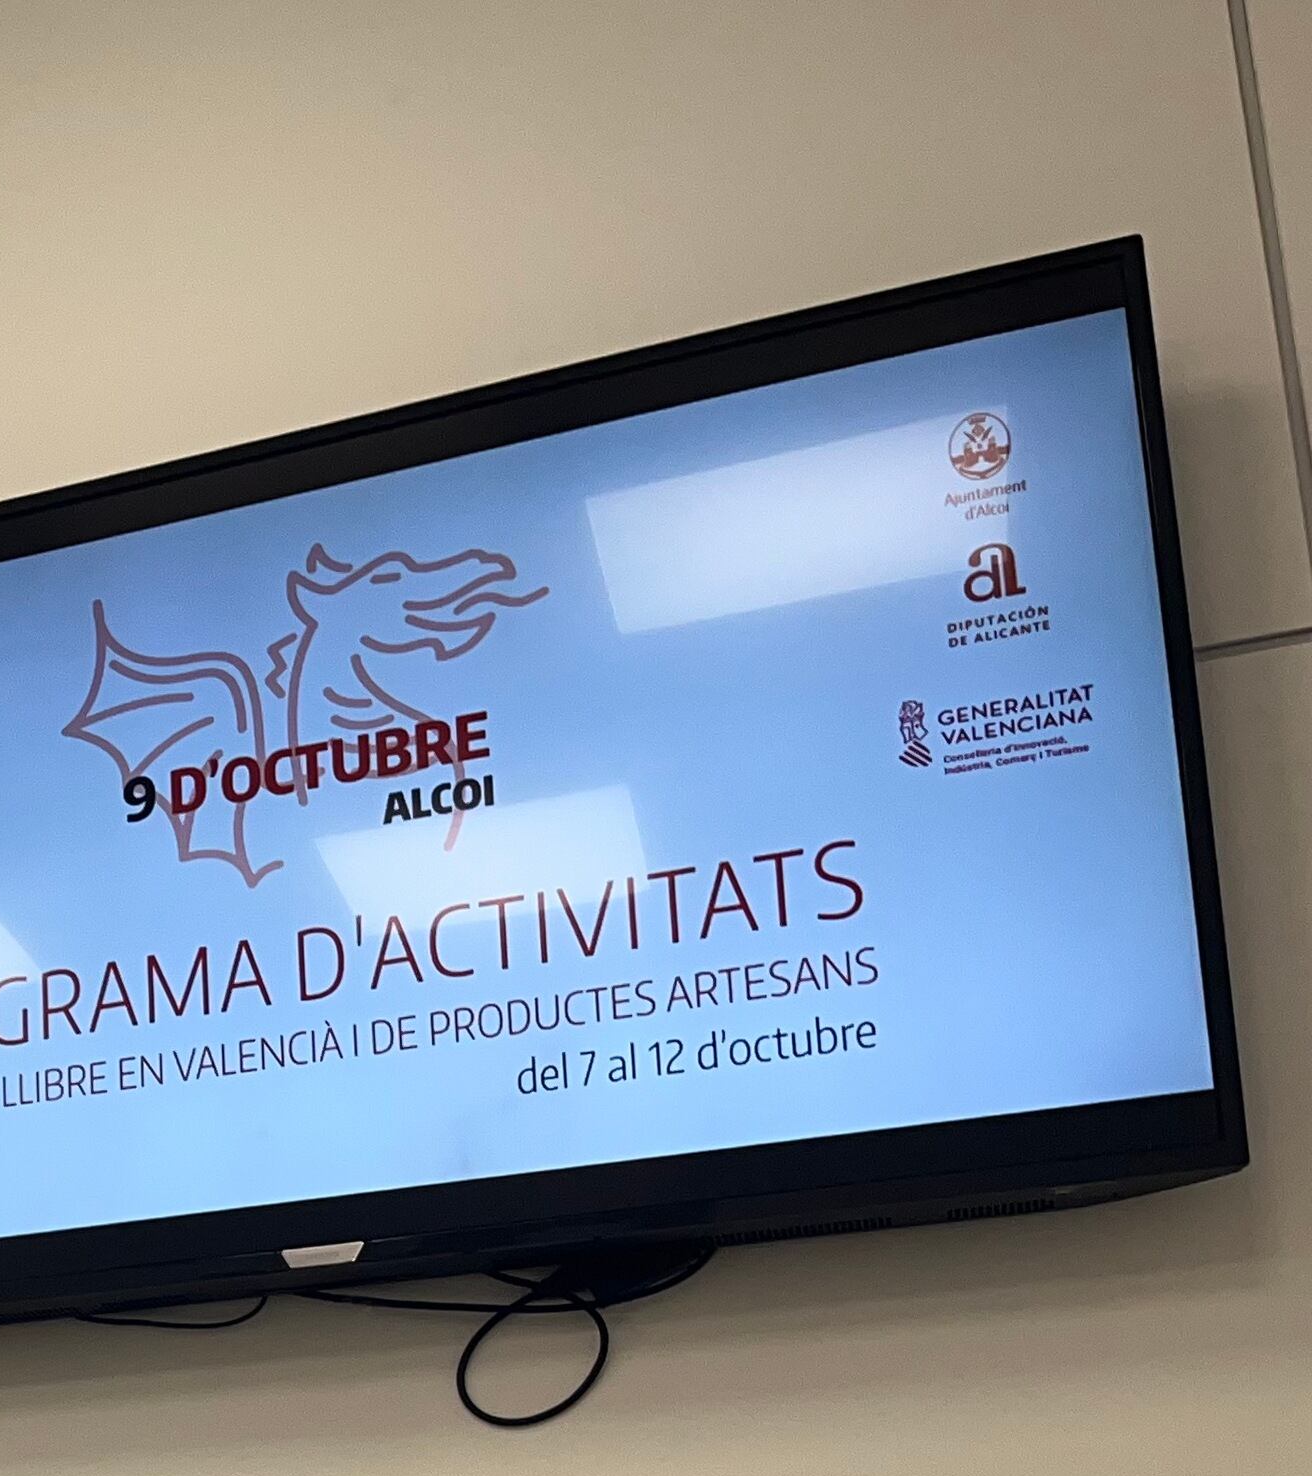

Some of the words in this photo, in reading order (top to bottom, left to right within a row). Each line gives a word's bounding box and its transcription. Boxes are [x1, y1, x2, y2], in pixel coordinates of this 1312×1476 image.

[944, 479, 1027, 508] Ajuntament
[964, 501, 1010, 521] d'Alcoi
[946, 605, 1050, 634] DIPUTACIÓN
[948, 635, 968, 648] DE
[974, 619, 1051, 644] ALICANTE
[937, 684, 1094, 726] GENERALITAT
[940, 706, 1093, 745] VALENCIANA
[122, 775, 157, 823] 9
[170, 711, 490, 815] D'OCTUBRE
[995, 751, 1037, 767] Comerç
[1044, 744, 1090, 758] Turisme
[382, 774, 495, 825] ALCOI
[296, 839, 865, 1001] D'ACTIVITATS
[2, 1060, 108, 1109] LLIBRE
[119, 1053, 164, 1092] EN
[173, 1020, 344, 1082] VALENCIÀ
[352, 1023, 359, 1056] I
[372, 1015, 418, 1055] DE
[429, 979, 656, 1046] PRODUCTES
[665, 946, 879, 1013] ARTESANS
[517, 1050, 568, 1095] del
[579, 1051, 597, 1086] 7
[608, 1043, 637, 1082] al
[650, 1039, 686, 1076] 12
[697, 1016, 877, 1070] d'octubre
